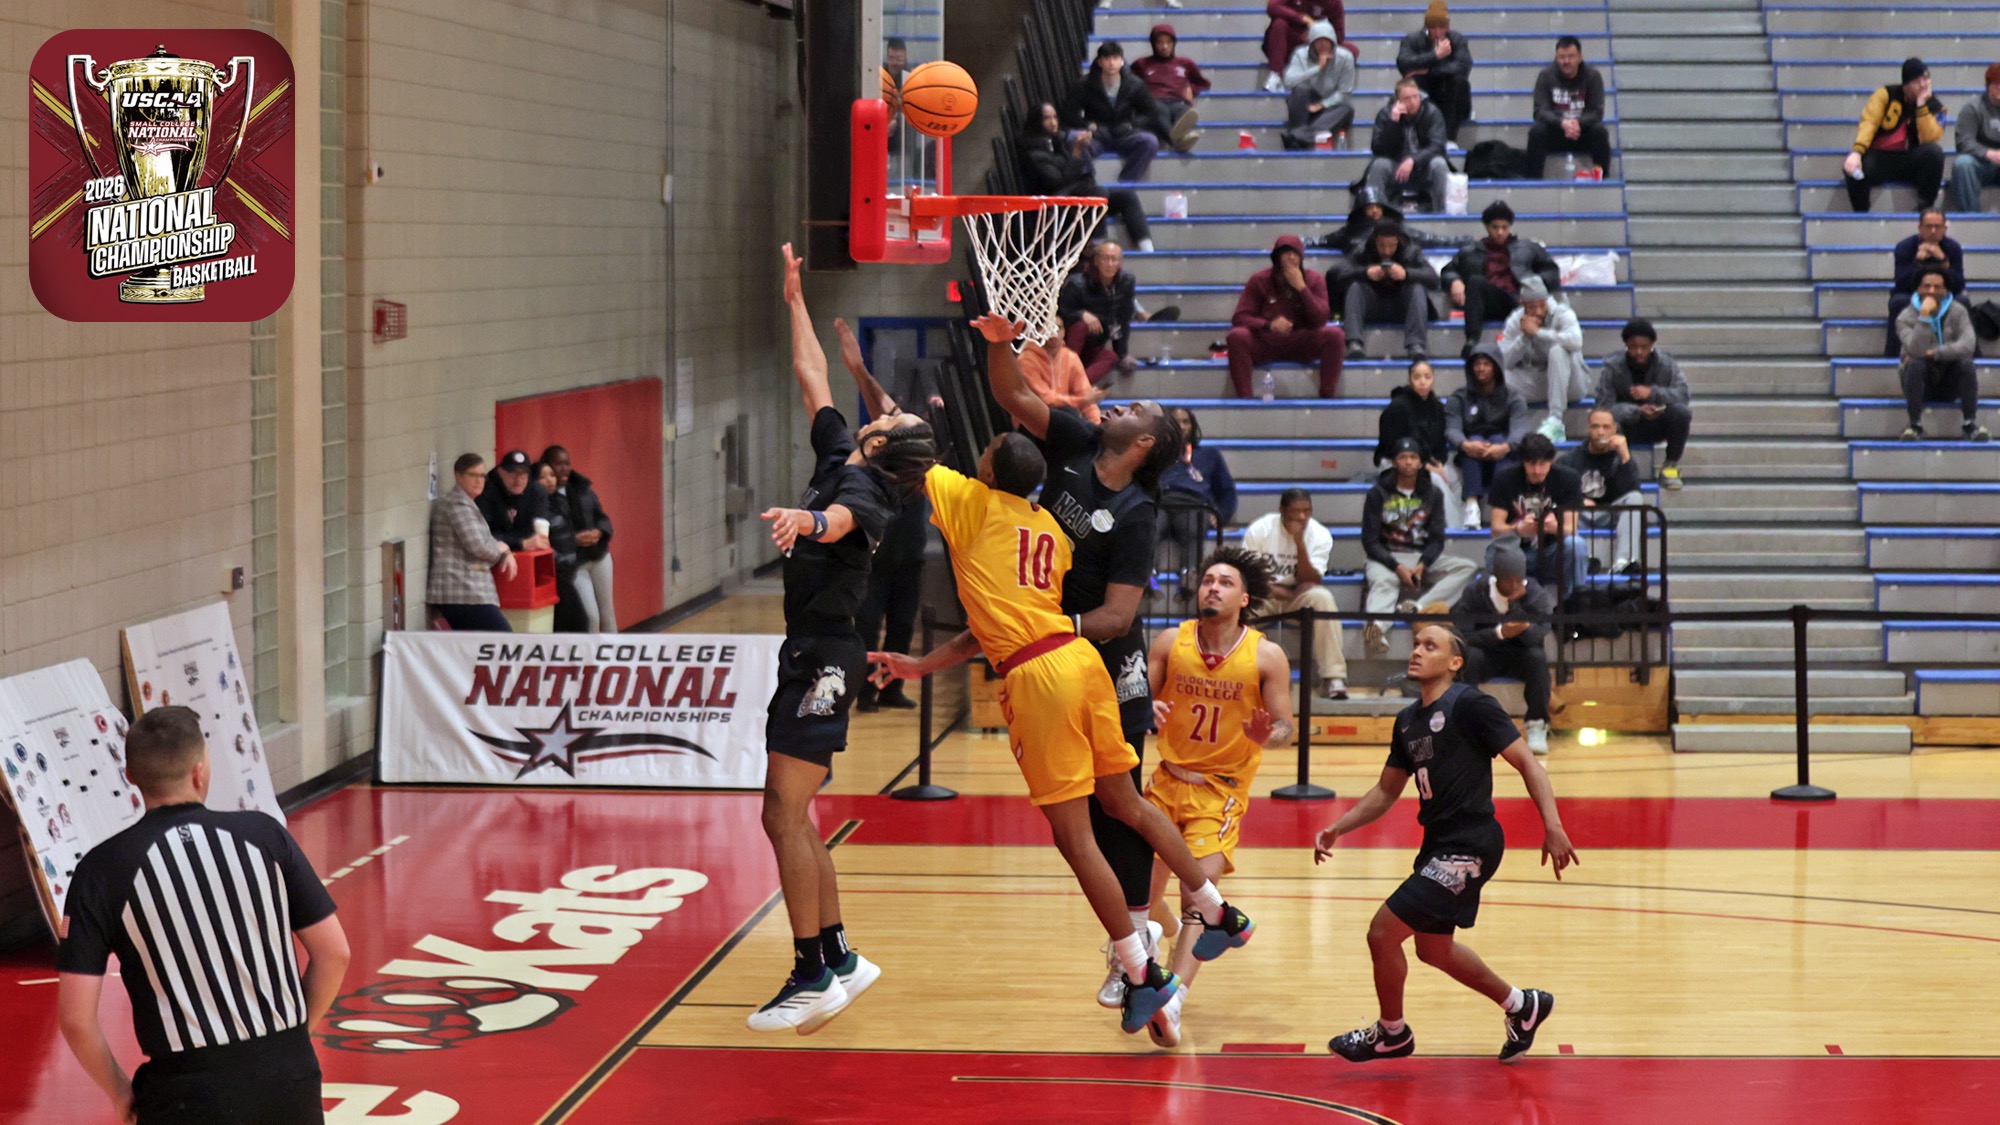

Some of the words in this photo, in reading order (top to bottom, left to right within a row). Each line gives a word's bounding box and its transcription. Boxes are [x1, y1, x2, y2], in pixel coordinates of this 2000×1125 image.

[1881, 101, 1903, 130] S
[1052, 491, 1092, 539] NAU
[1015, 525, 1055, 590] 10
[477, 644, 583, 661] SMALL
[596, 645, 737, 662] COLLEGE
[464, 665, 737, 708] NATIONAL
[1176, 674, 1244, 690] BLOOMFIELD
[1176, 684, 1241, 700] COLLEGE
[578, 710, 731, 722] CHAMPIONSHIPS
[1189, 702, 1222, 744] 21
[1417, 767, 1433, 800] 0
[377, 864, 709, 992] Kats
